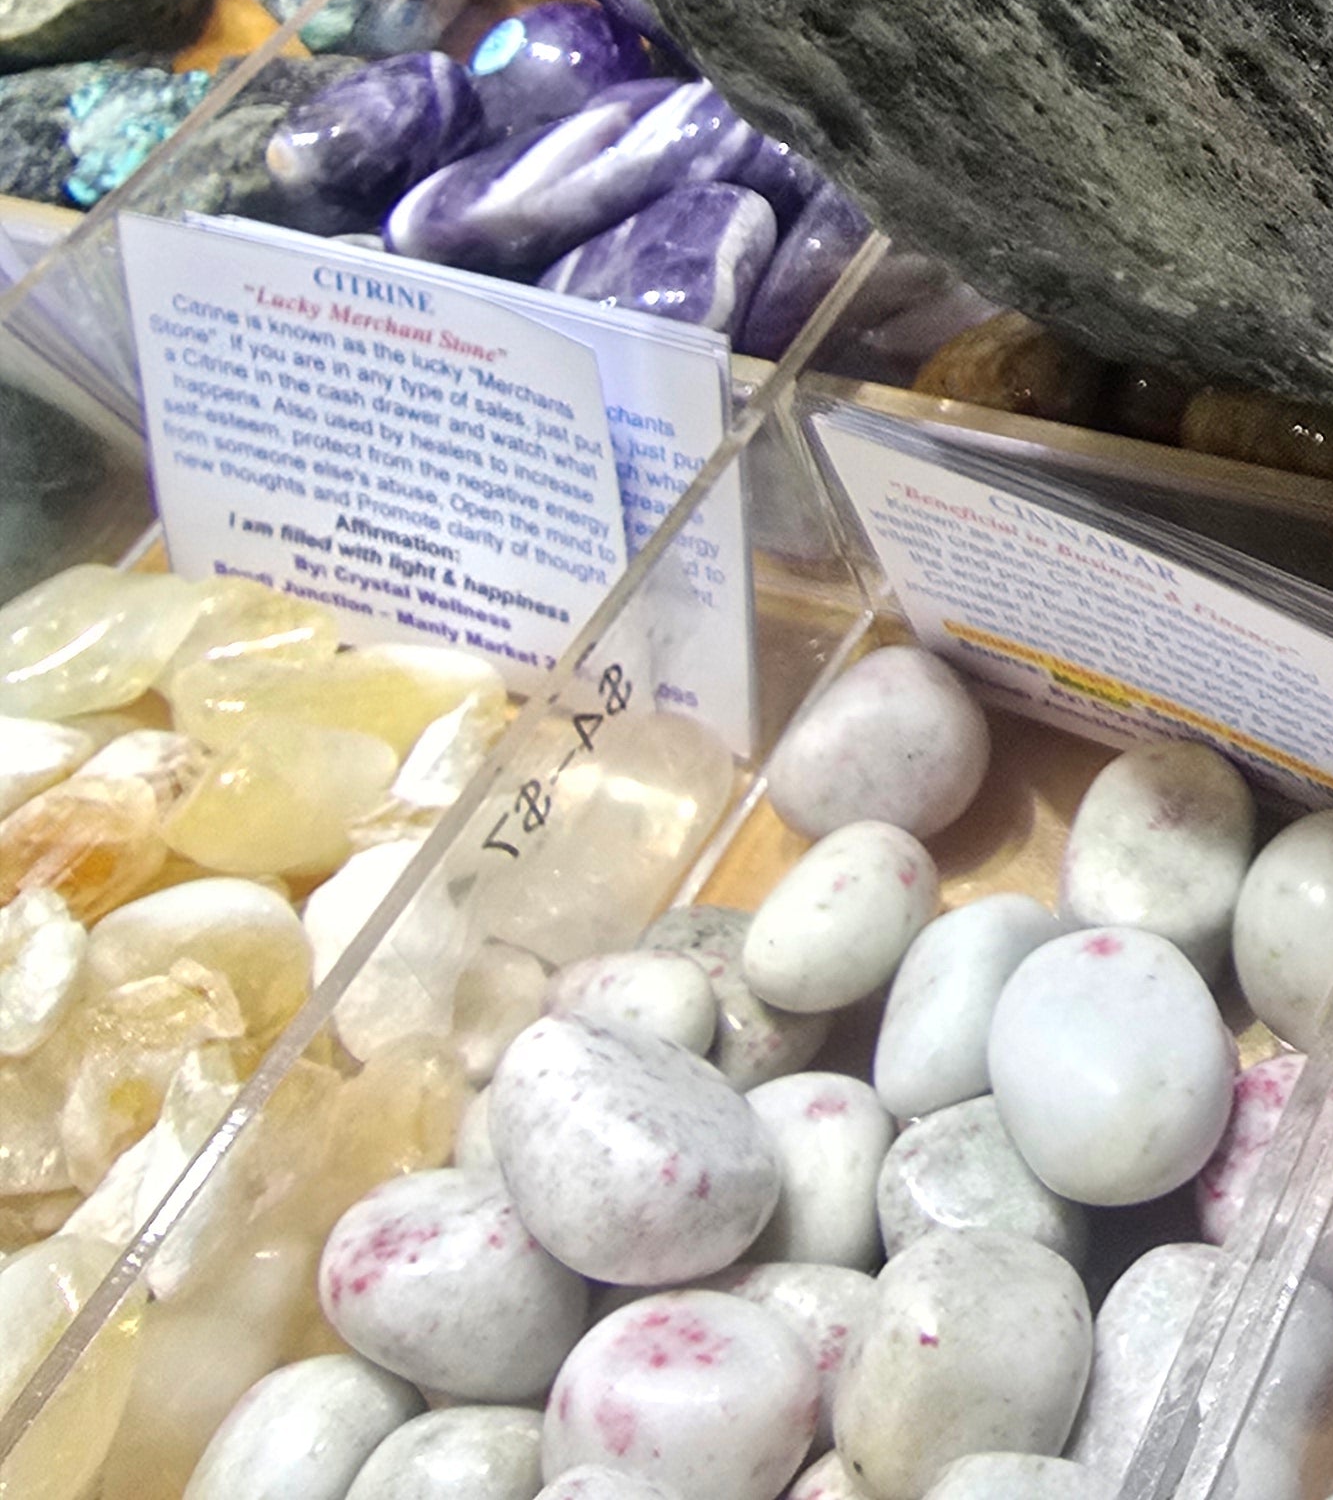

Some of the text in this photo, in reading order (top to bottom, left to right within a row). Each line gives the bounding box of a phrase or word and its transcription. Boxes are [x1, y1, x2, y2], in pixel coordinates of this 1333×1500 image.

[244, 284, 507, 363] “Lucky Merchant Stone”
[313, 268, 436, 313] CITRINE
[229, 512, 569, 623] I am filled with light & happiness
[336, 514, 460, 565] Affirmation:
[988, 493, 1181, 587] CINNABAR
